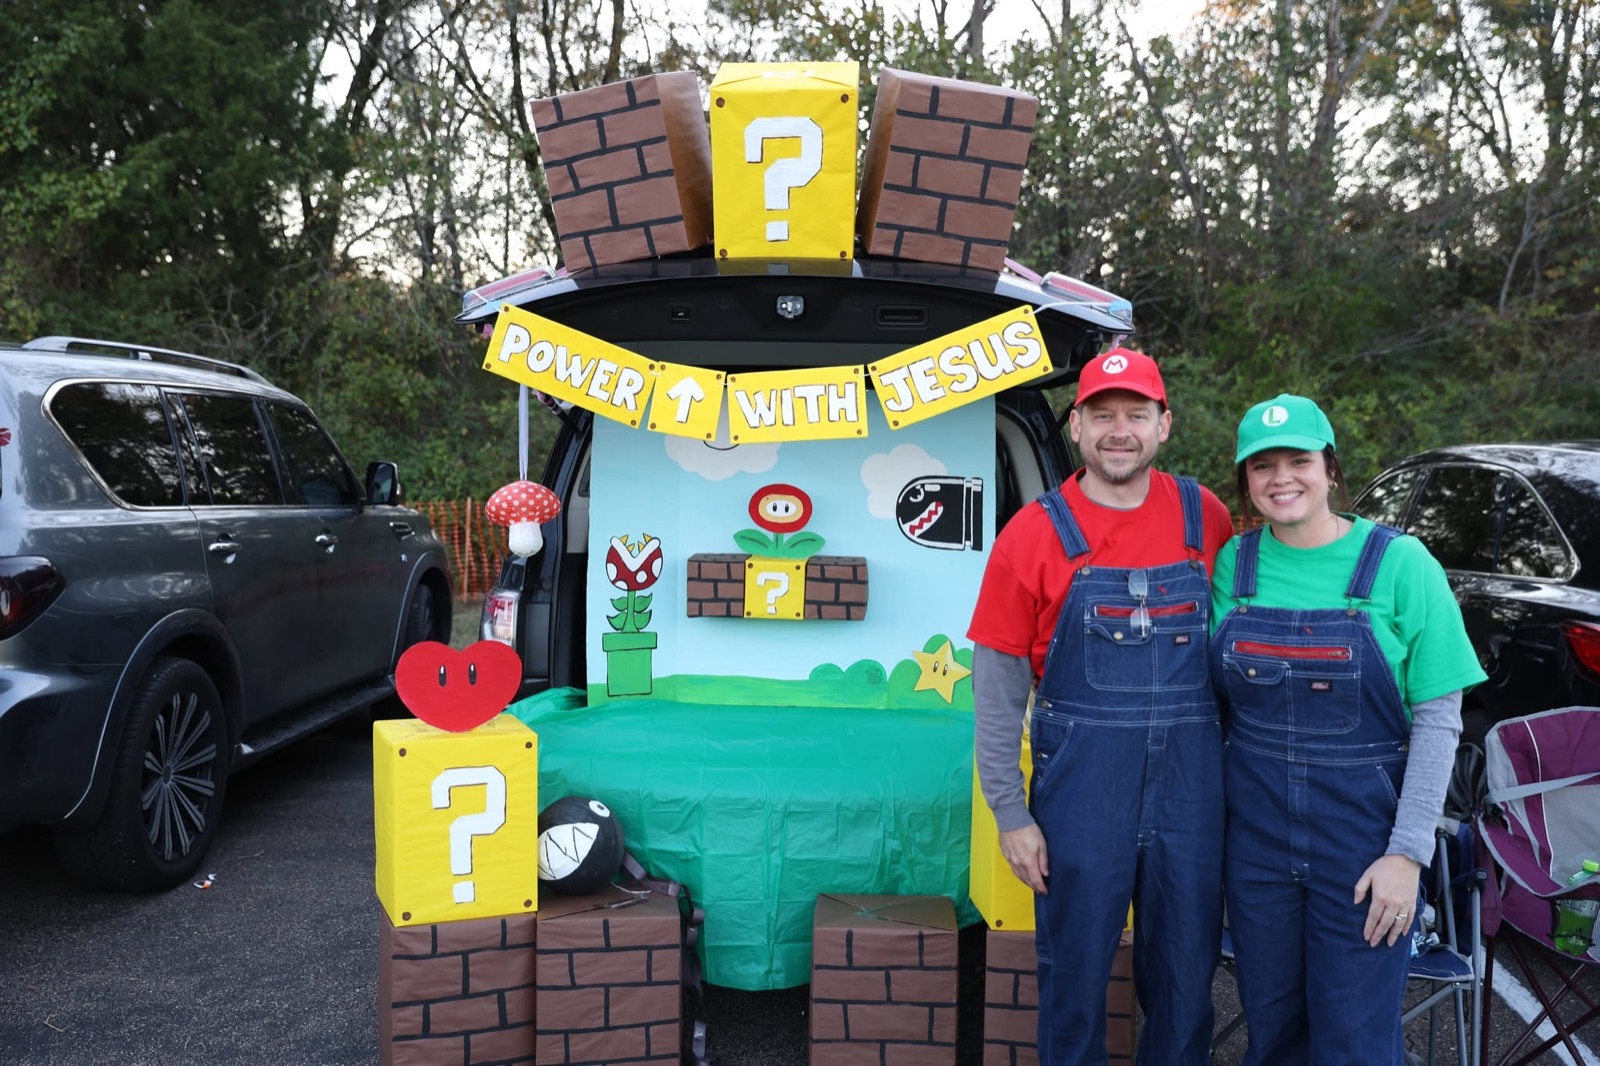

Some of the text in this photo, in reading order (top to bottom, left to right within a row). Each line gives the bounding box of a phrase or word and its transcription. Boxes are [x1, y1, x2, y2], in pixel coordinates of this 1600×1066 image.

[744, 116, 824, 243] ?
[498, 321, 1041, 428] POWER WITH JESUS
[1105, 359, 1124, 371] M
[1268, 407, 1281, 425] L
[756, 572, 789, 615] ?
[431, 765, 507, 904] ?
